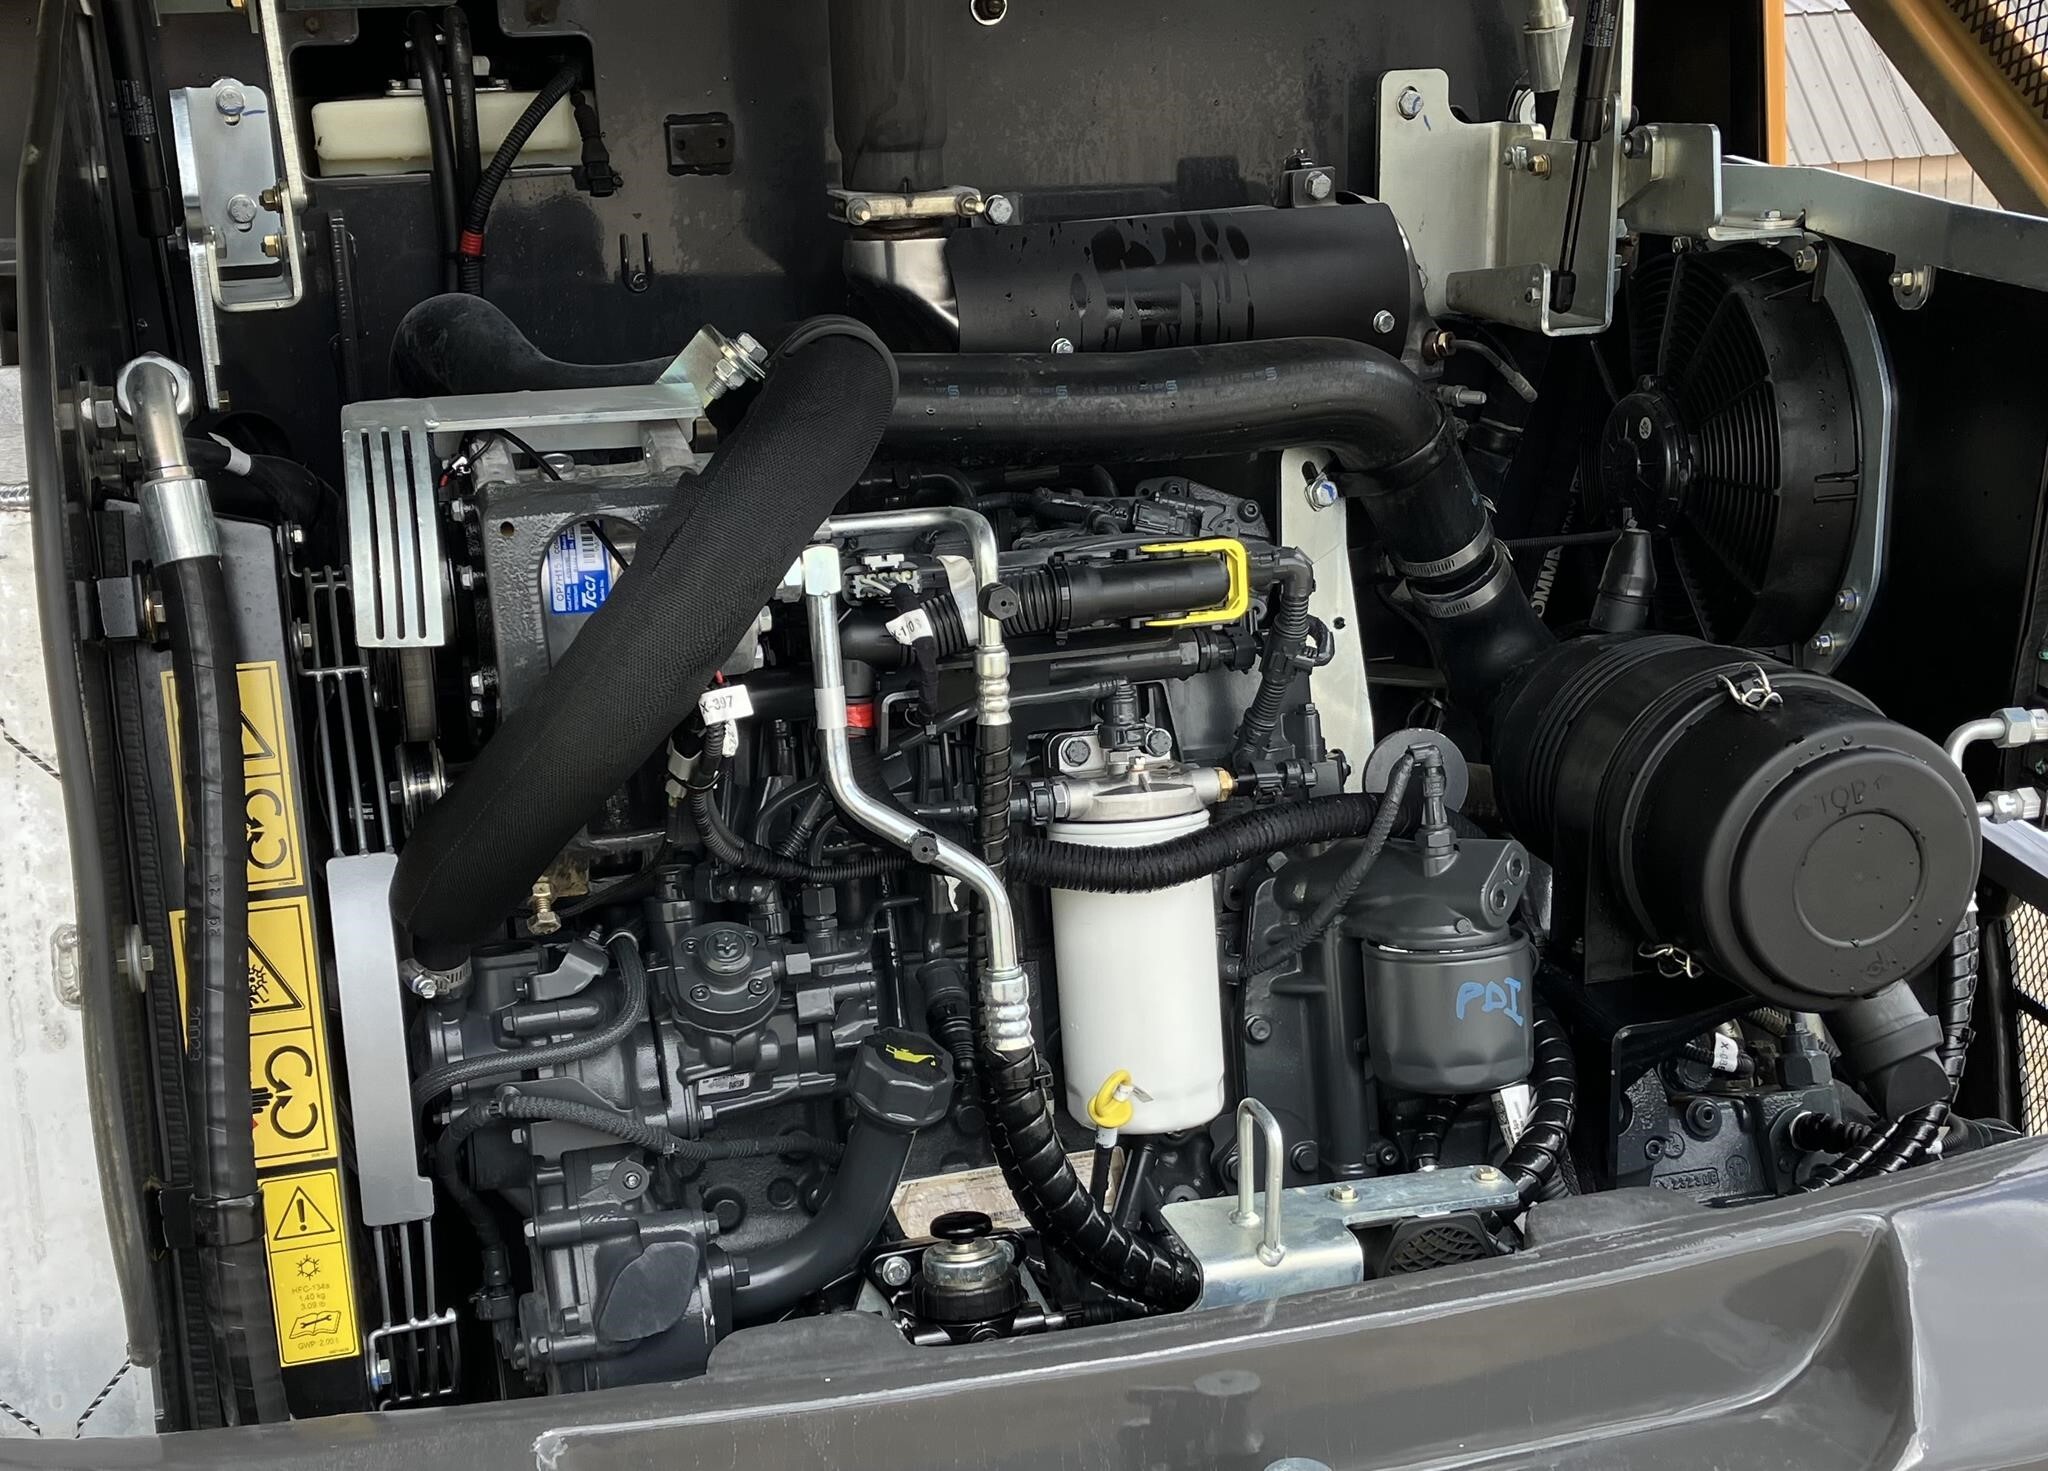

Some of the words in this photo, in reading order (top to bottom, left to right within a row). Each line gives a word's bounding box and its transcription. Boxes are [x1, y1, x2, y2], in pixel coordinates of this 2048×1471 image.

[580, 574, 598, 609] TCCI
[699, 694, 733, 714] X-397
[1456, 977, 1524, 1027] PDI
